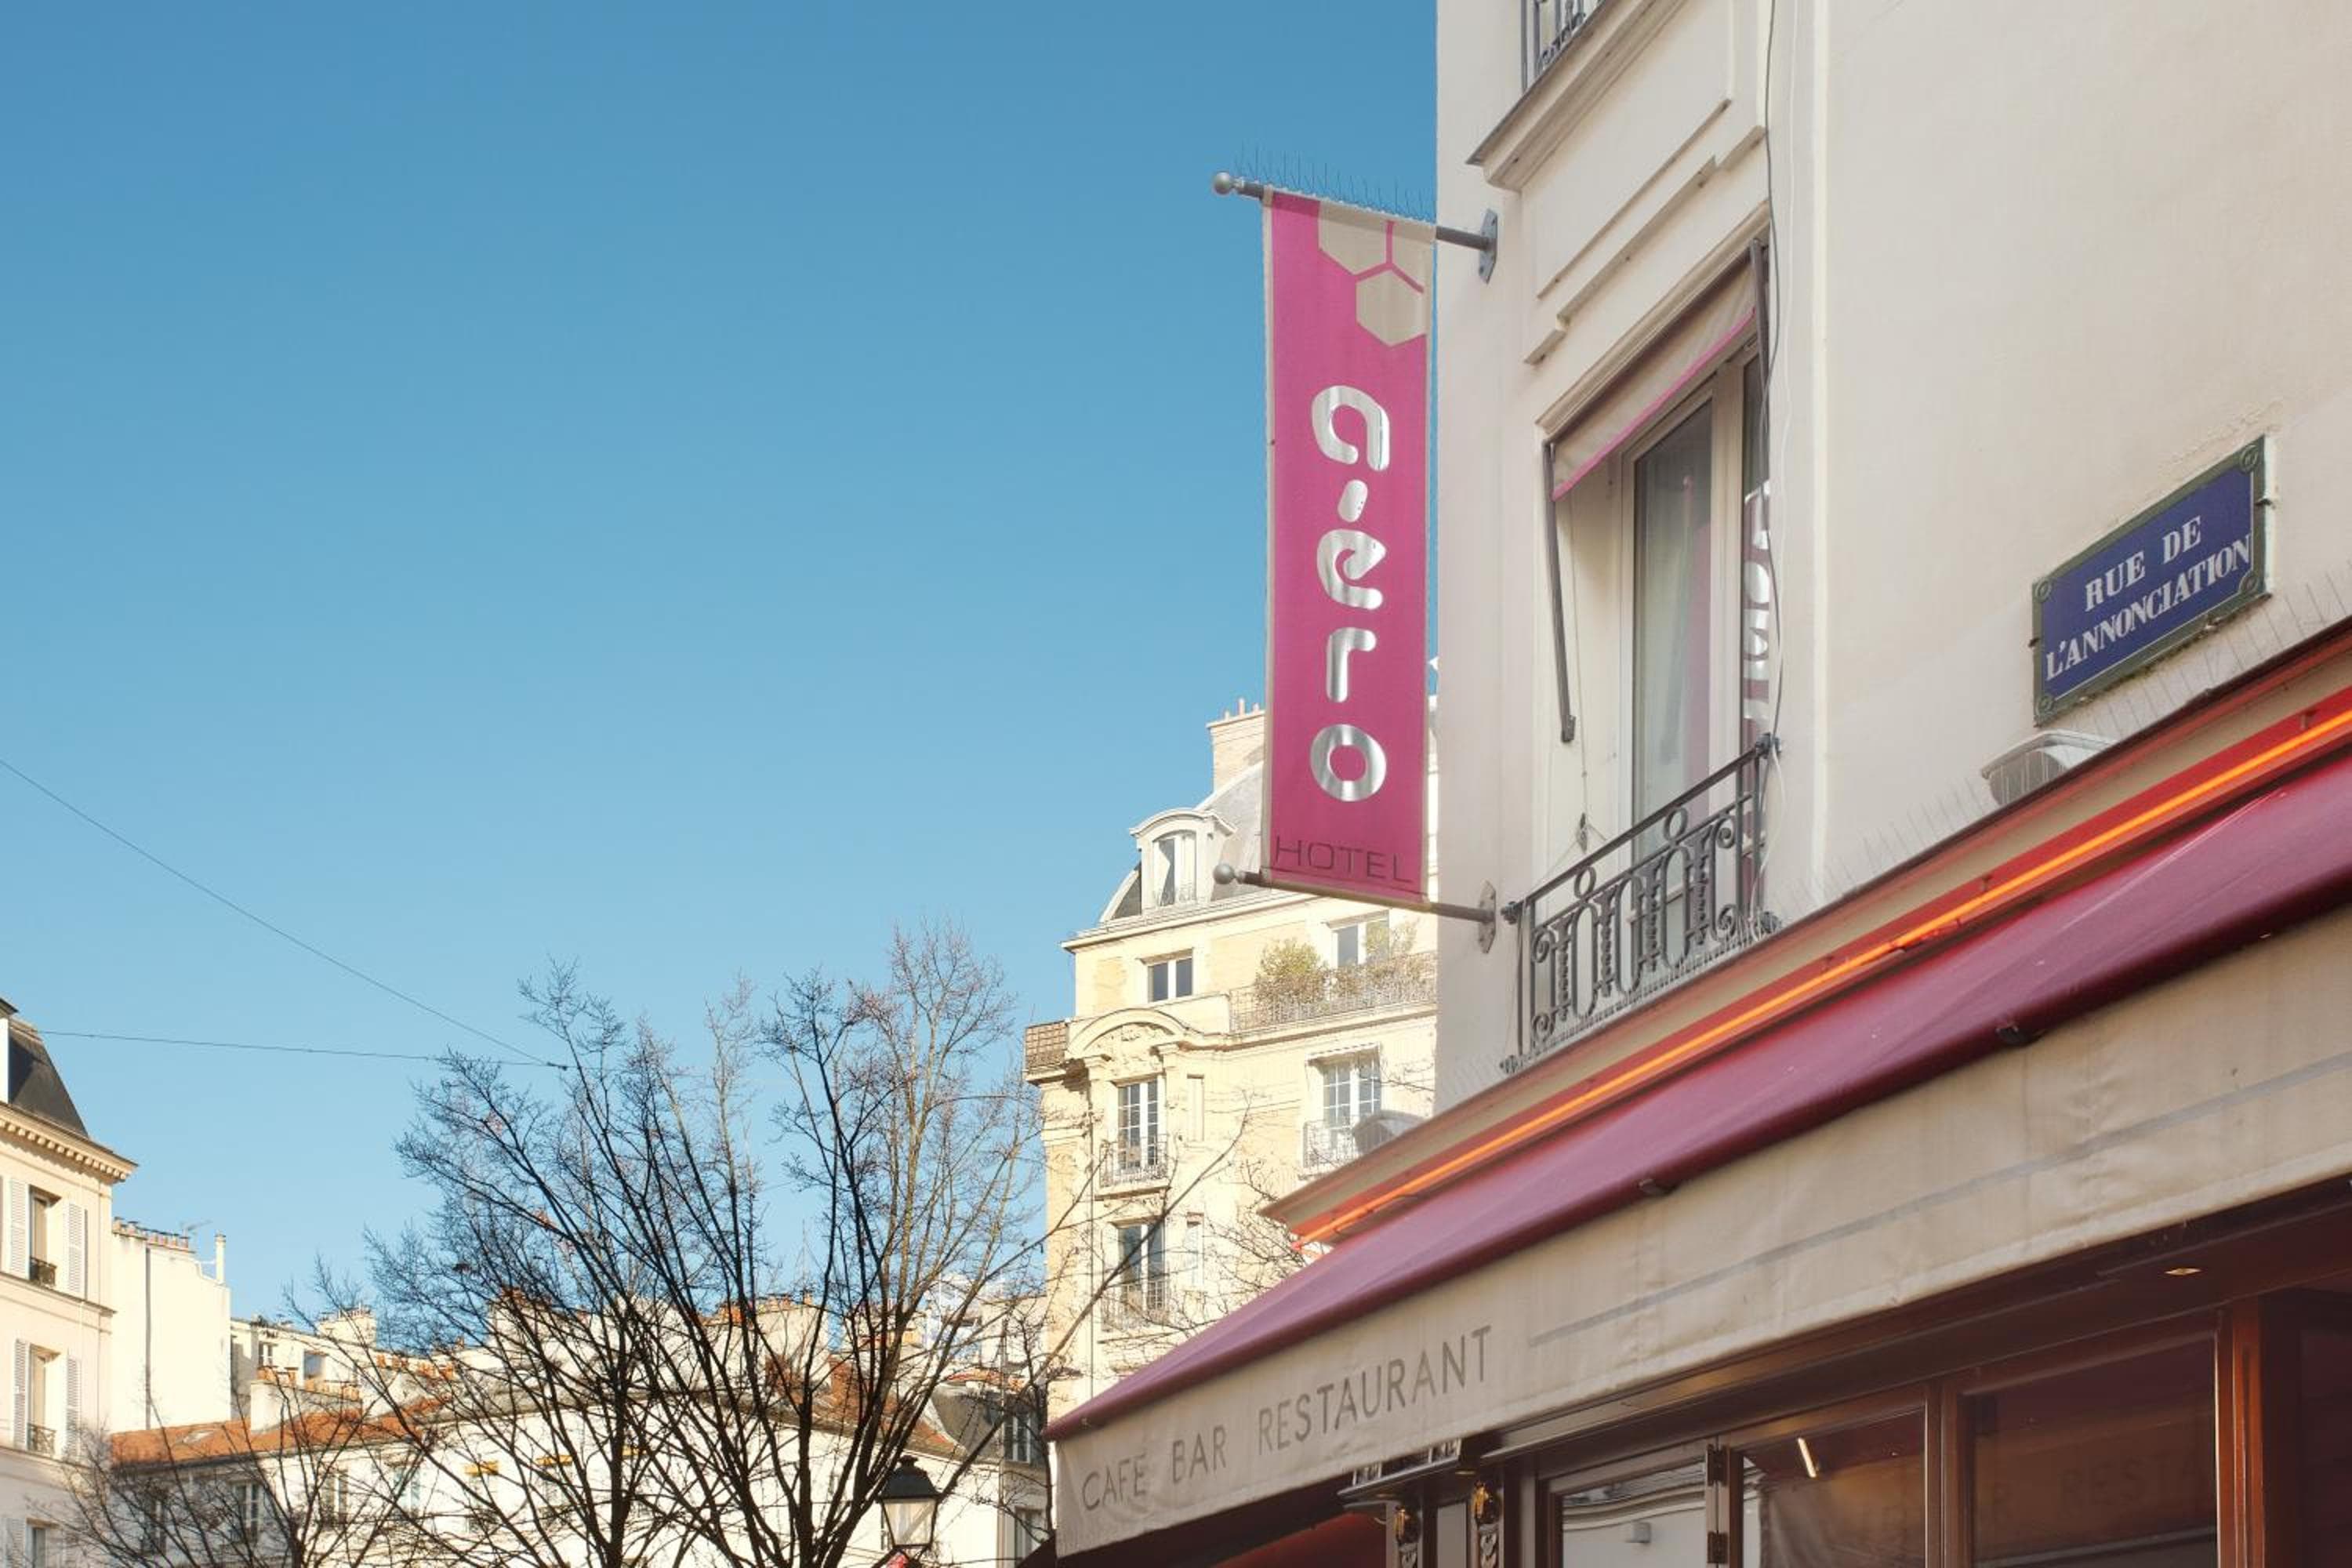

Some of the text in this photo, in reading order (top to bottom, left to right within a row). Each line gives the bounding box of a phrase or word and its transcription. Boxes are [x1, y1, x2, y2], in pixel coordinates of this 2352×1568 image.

[2046, 535, 2252, 681] L'ANNONCIATION
[2085, 516, 2201, 612] RUE DE
[1273, 836, 1412, 884] HOTEL
[1172, 1425, 1227, 1484] BAR
[1258, 1325, 1491, 1456] RESTAURANT
